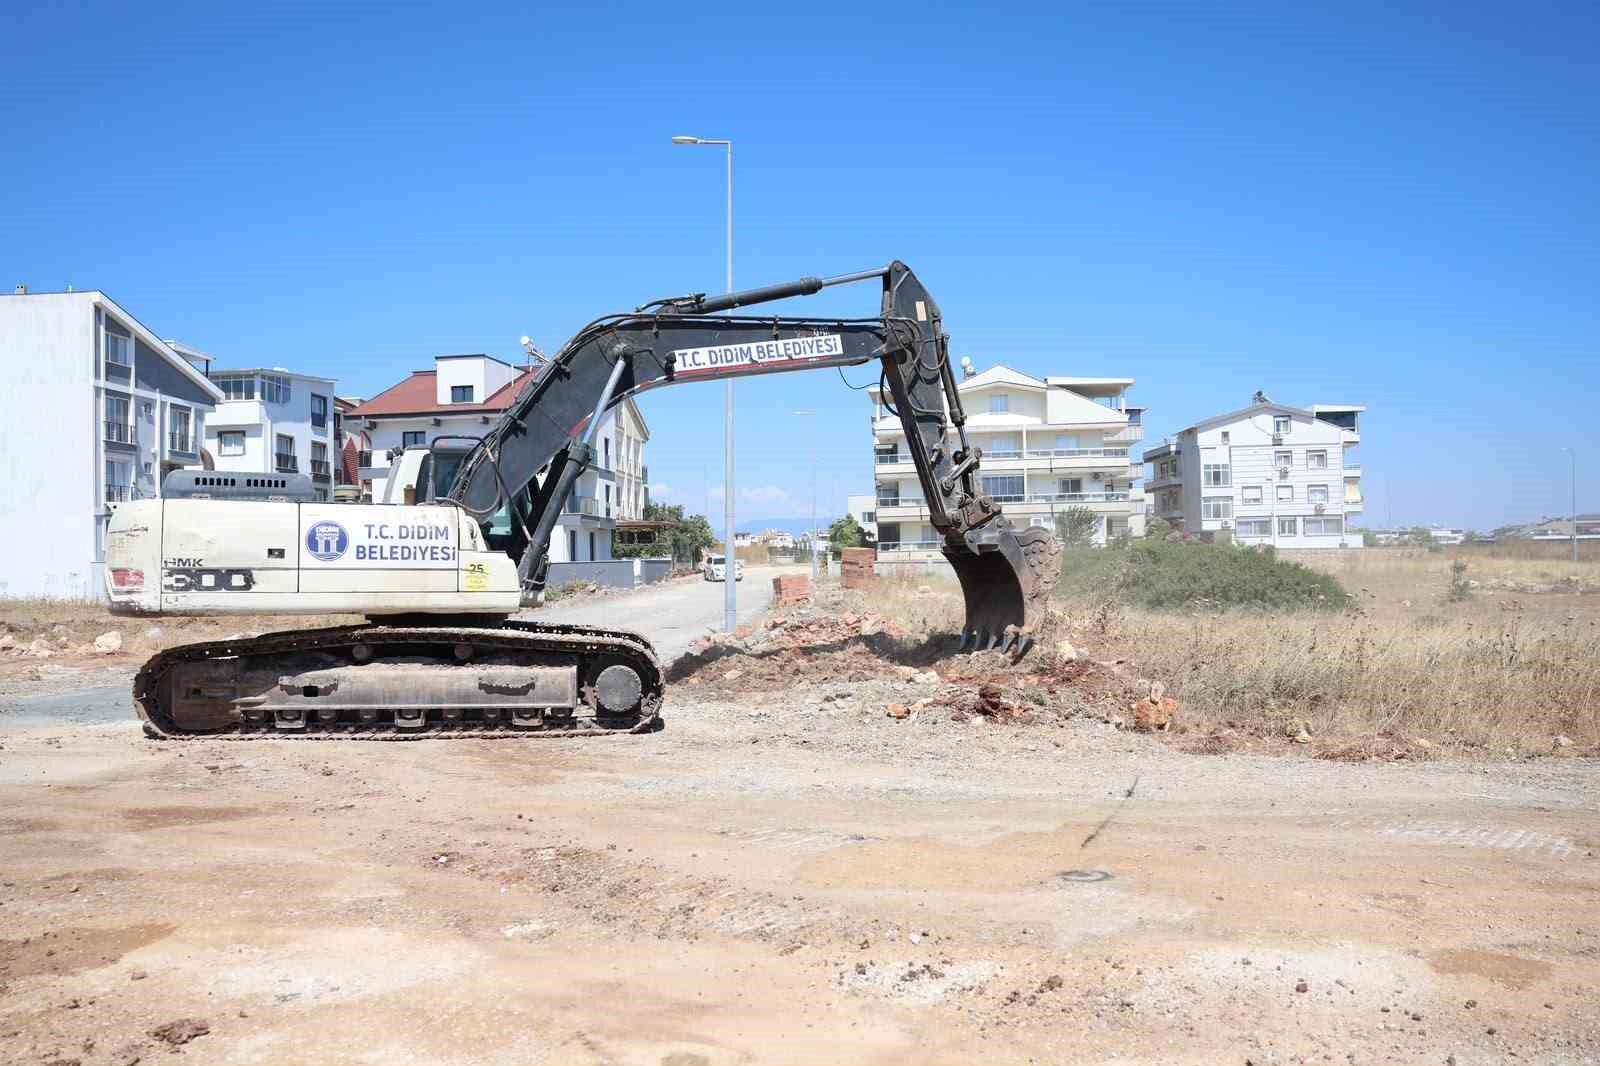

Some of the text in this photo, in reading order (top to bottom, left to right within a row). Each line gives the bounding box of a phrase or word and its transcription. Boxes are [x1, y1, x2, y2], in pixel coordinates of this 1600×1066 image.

[678, 351, 706, 368] T.C.
[364, 524, 394, 540] T.C.
[469, 563, 484, 574] 25
